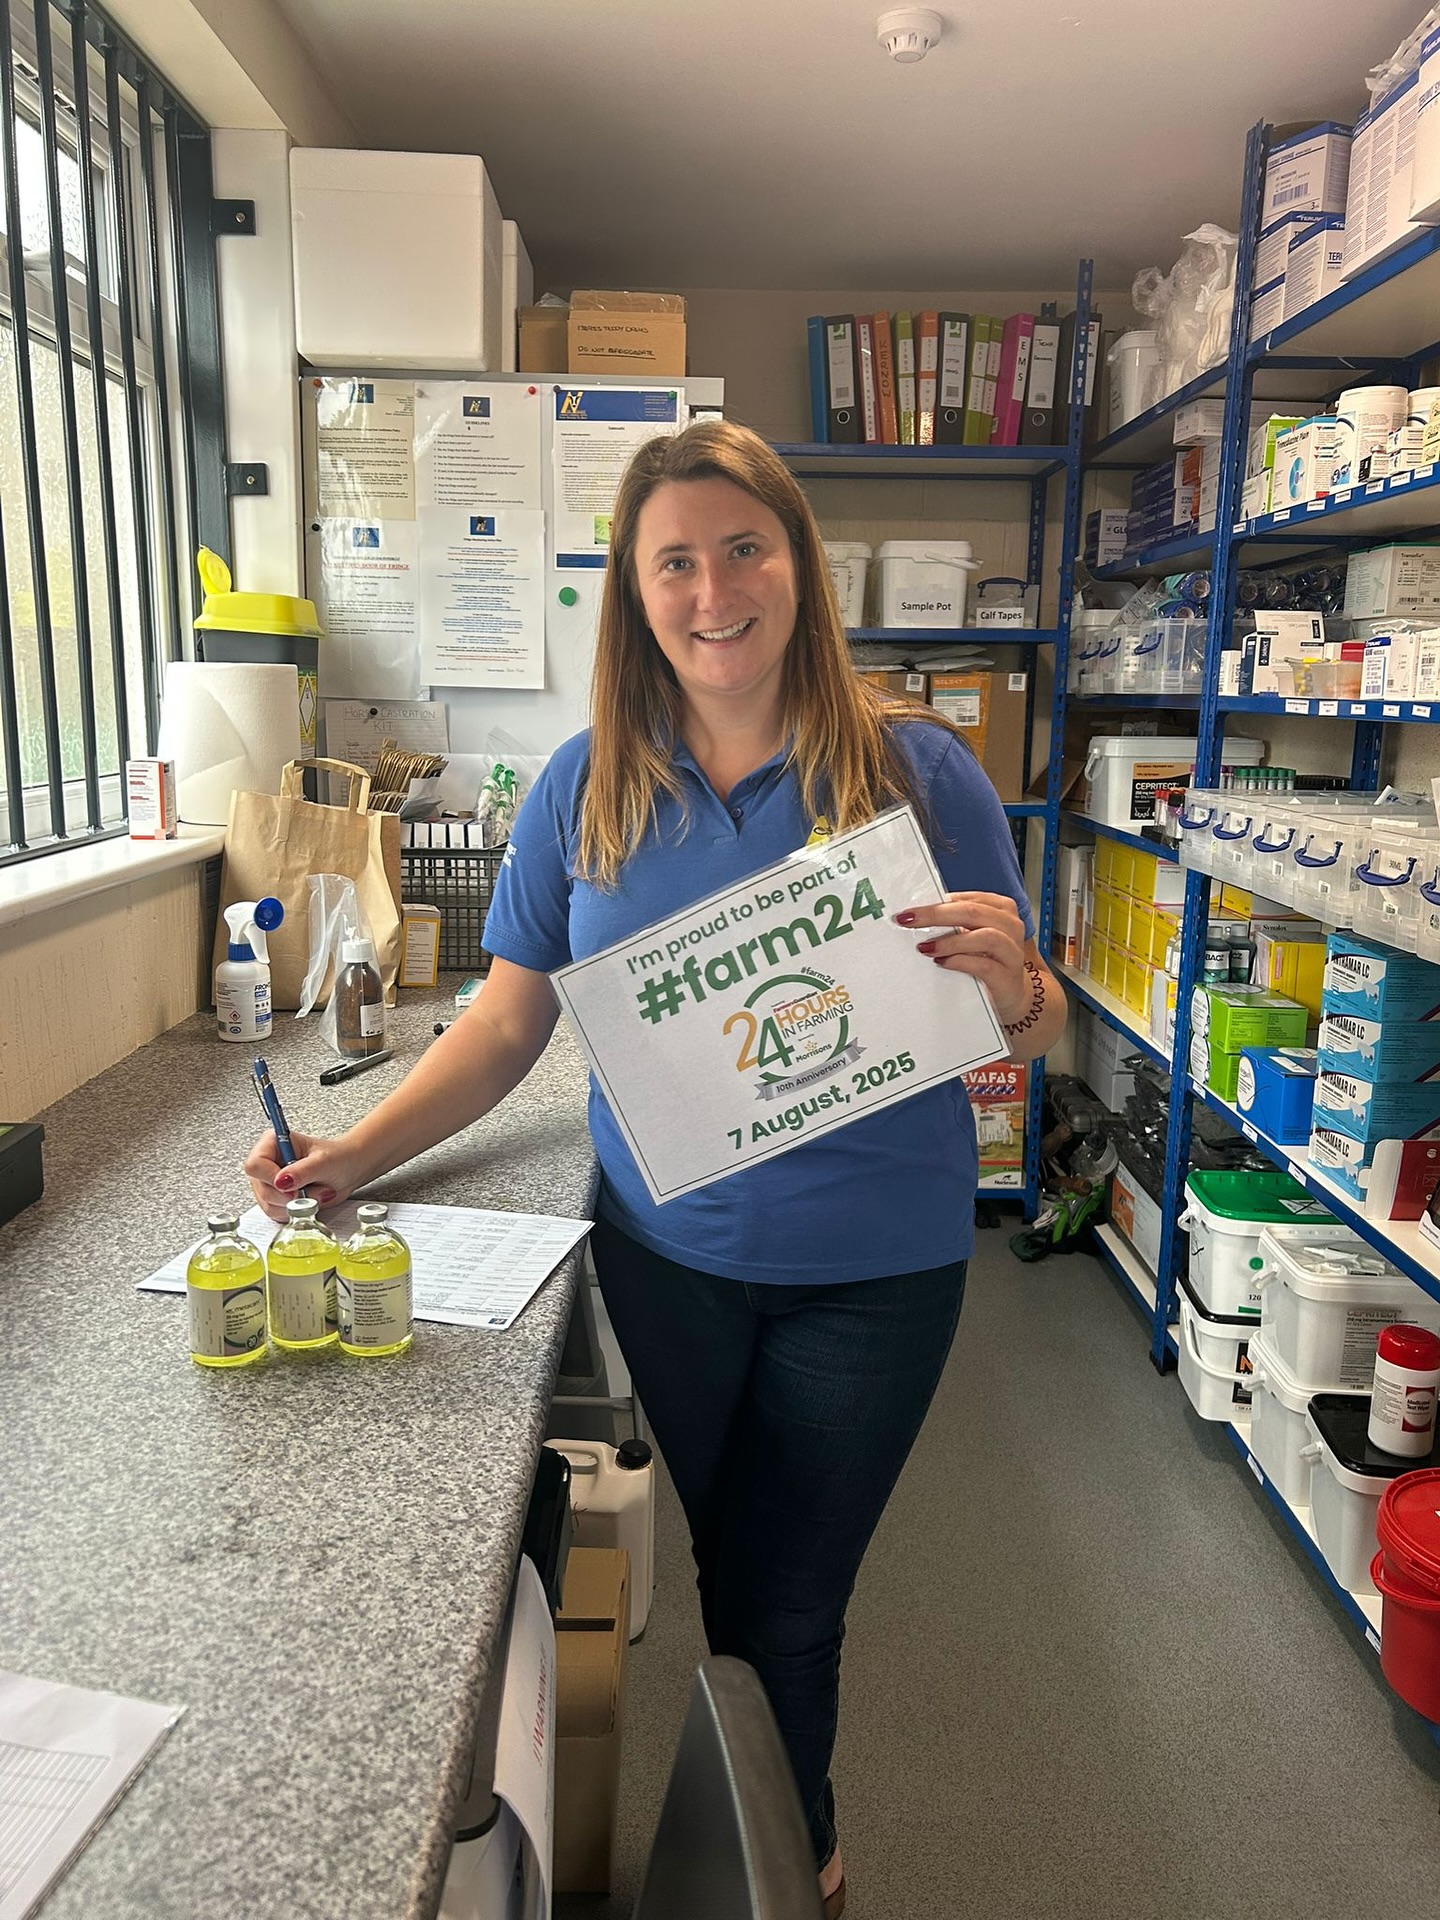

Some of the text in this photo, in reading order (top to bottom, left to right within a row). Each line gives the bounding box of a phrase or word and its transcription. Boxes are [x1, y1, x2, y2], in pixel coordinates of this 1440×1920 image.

[1017, 341, 1027, 382] EMS
[901, 601, 952, 613] Sample Pot
[980, 610, 1023, 621] Calf Tapes
[380, 706, 437, 720] CASTRATION
[373, 721, 394, 733] KIT
[626, 850, 859, 976] I'm proud to be part of
[636, 877, 887, 1025] #farm24
[800, 966, 836, 985] #farm24
[1361, 962, 1371, 979] LC
[775, 984, 851, 1030] HOURS
[780, 1000, 855, 1040] IN FARMING
[1356, 1024, 1366, 1040] LC
[795, 1042, 833, 1063] Morrisons
[775, 1056, 848, 1094] 10th Anniversary
[960, 1071, 1018, 1084] EVAFAS
[727, 1050, 918, 1150] 7 August, 2025
[1348, 1083, 1358, 1099] LC
[1342, 1141, 1351, 1158] LC
